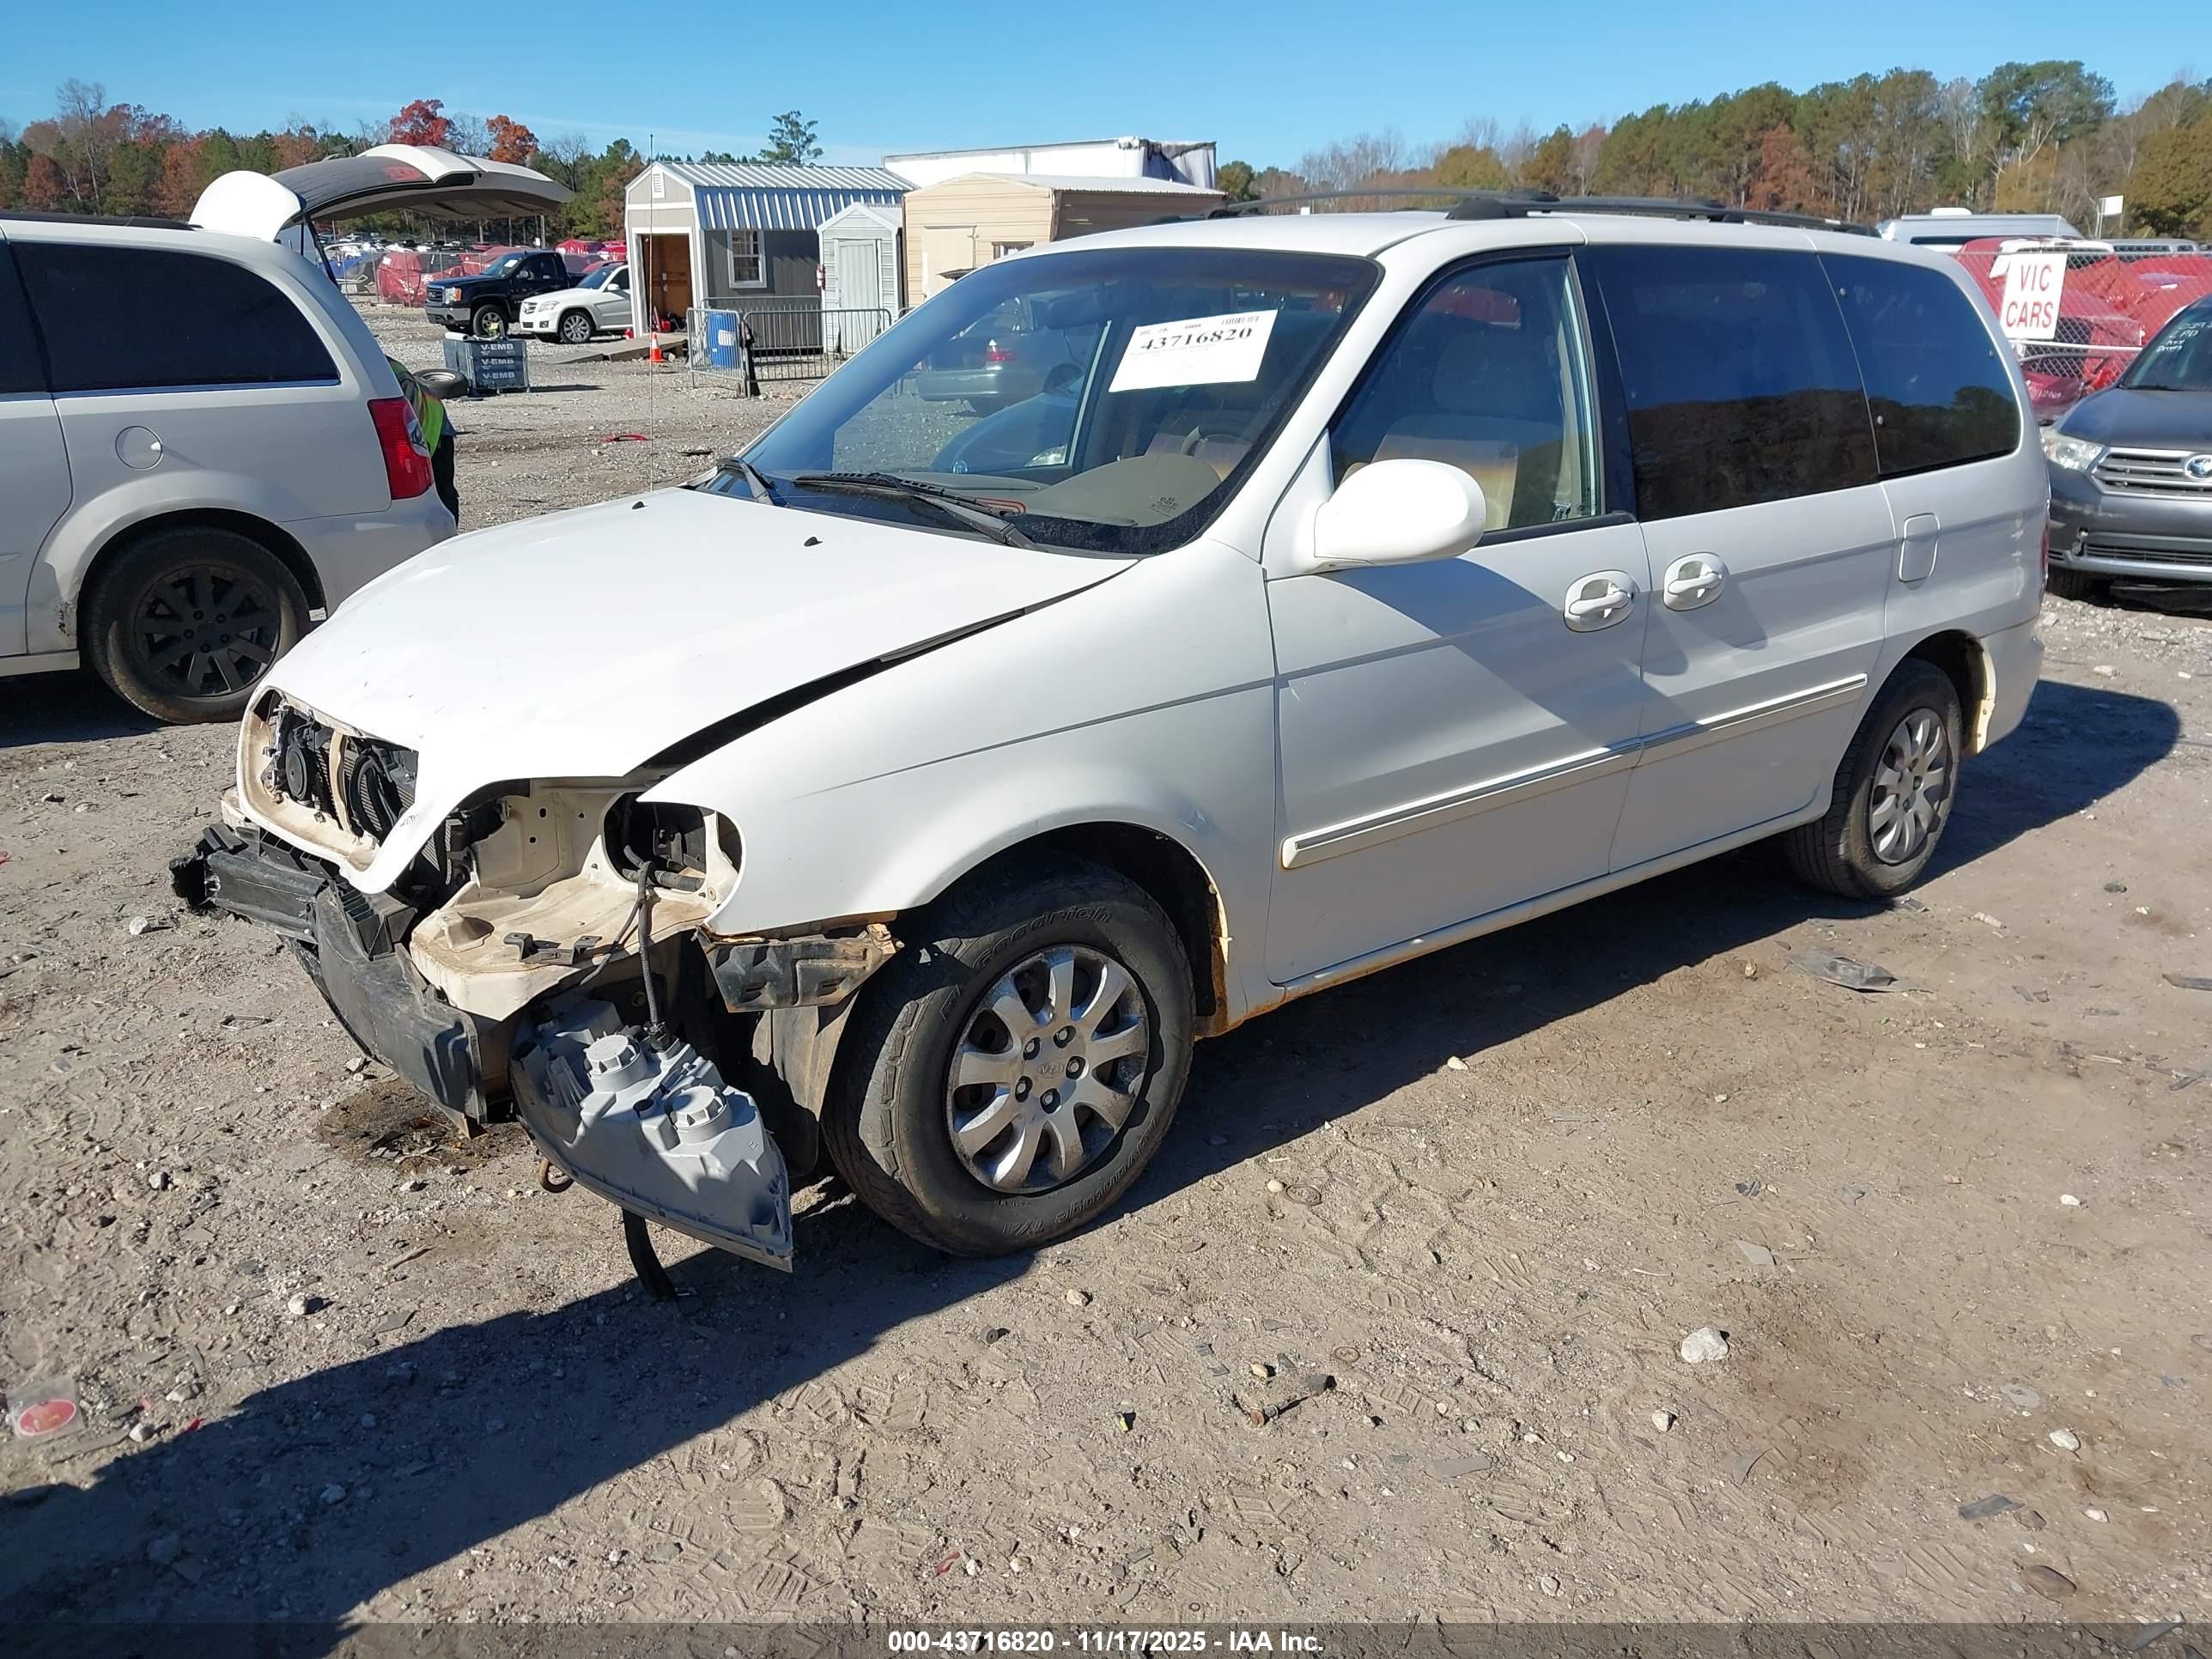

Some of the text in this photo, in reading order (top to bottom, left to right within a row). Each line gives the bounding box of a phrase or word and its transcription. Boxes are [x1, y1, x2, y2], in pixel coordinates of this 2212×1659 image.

[2021, 264, 2052, 292] VIC
[2005, 300, 2054, 328] CARS
[1139, 327, 1254, 351] 43716820
